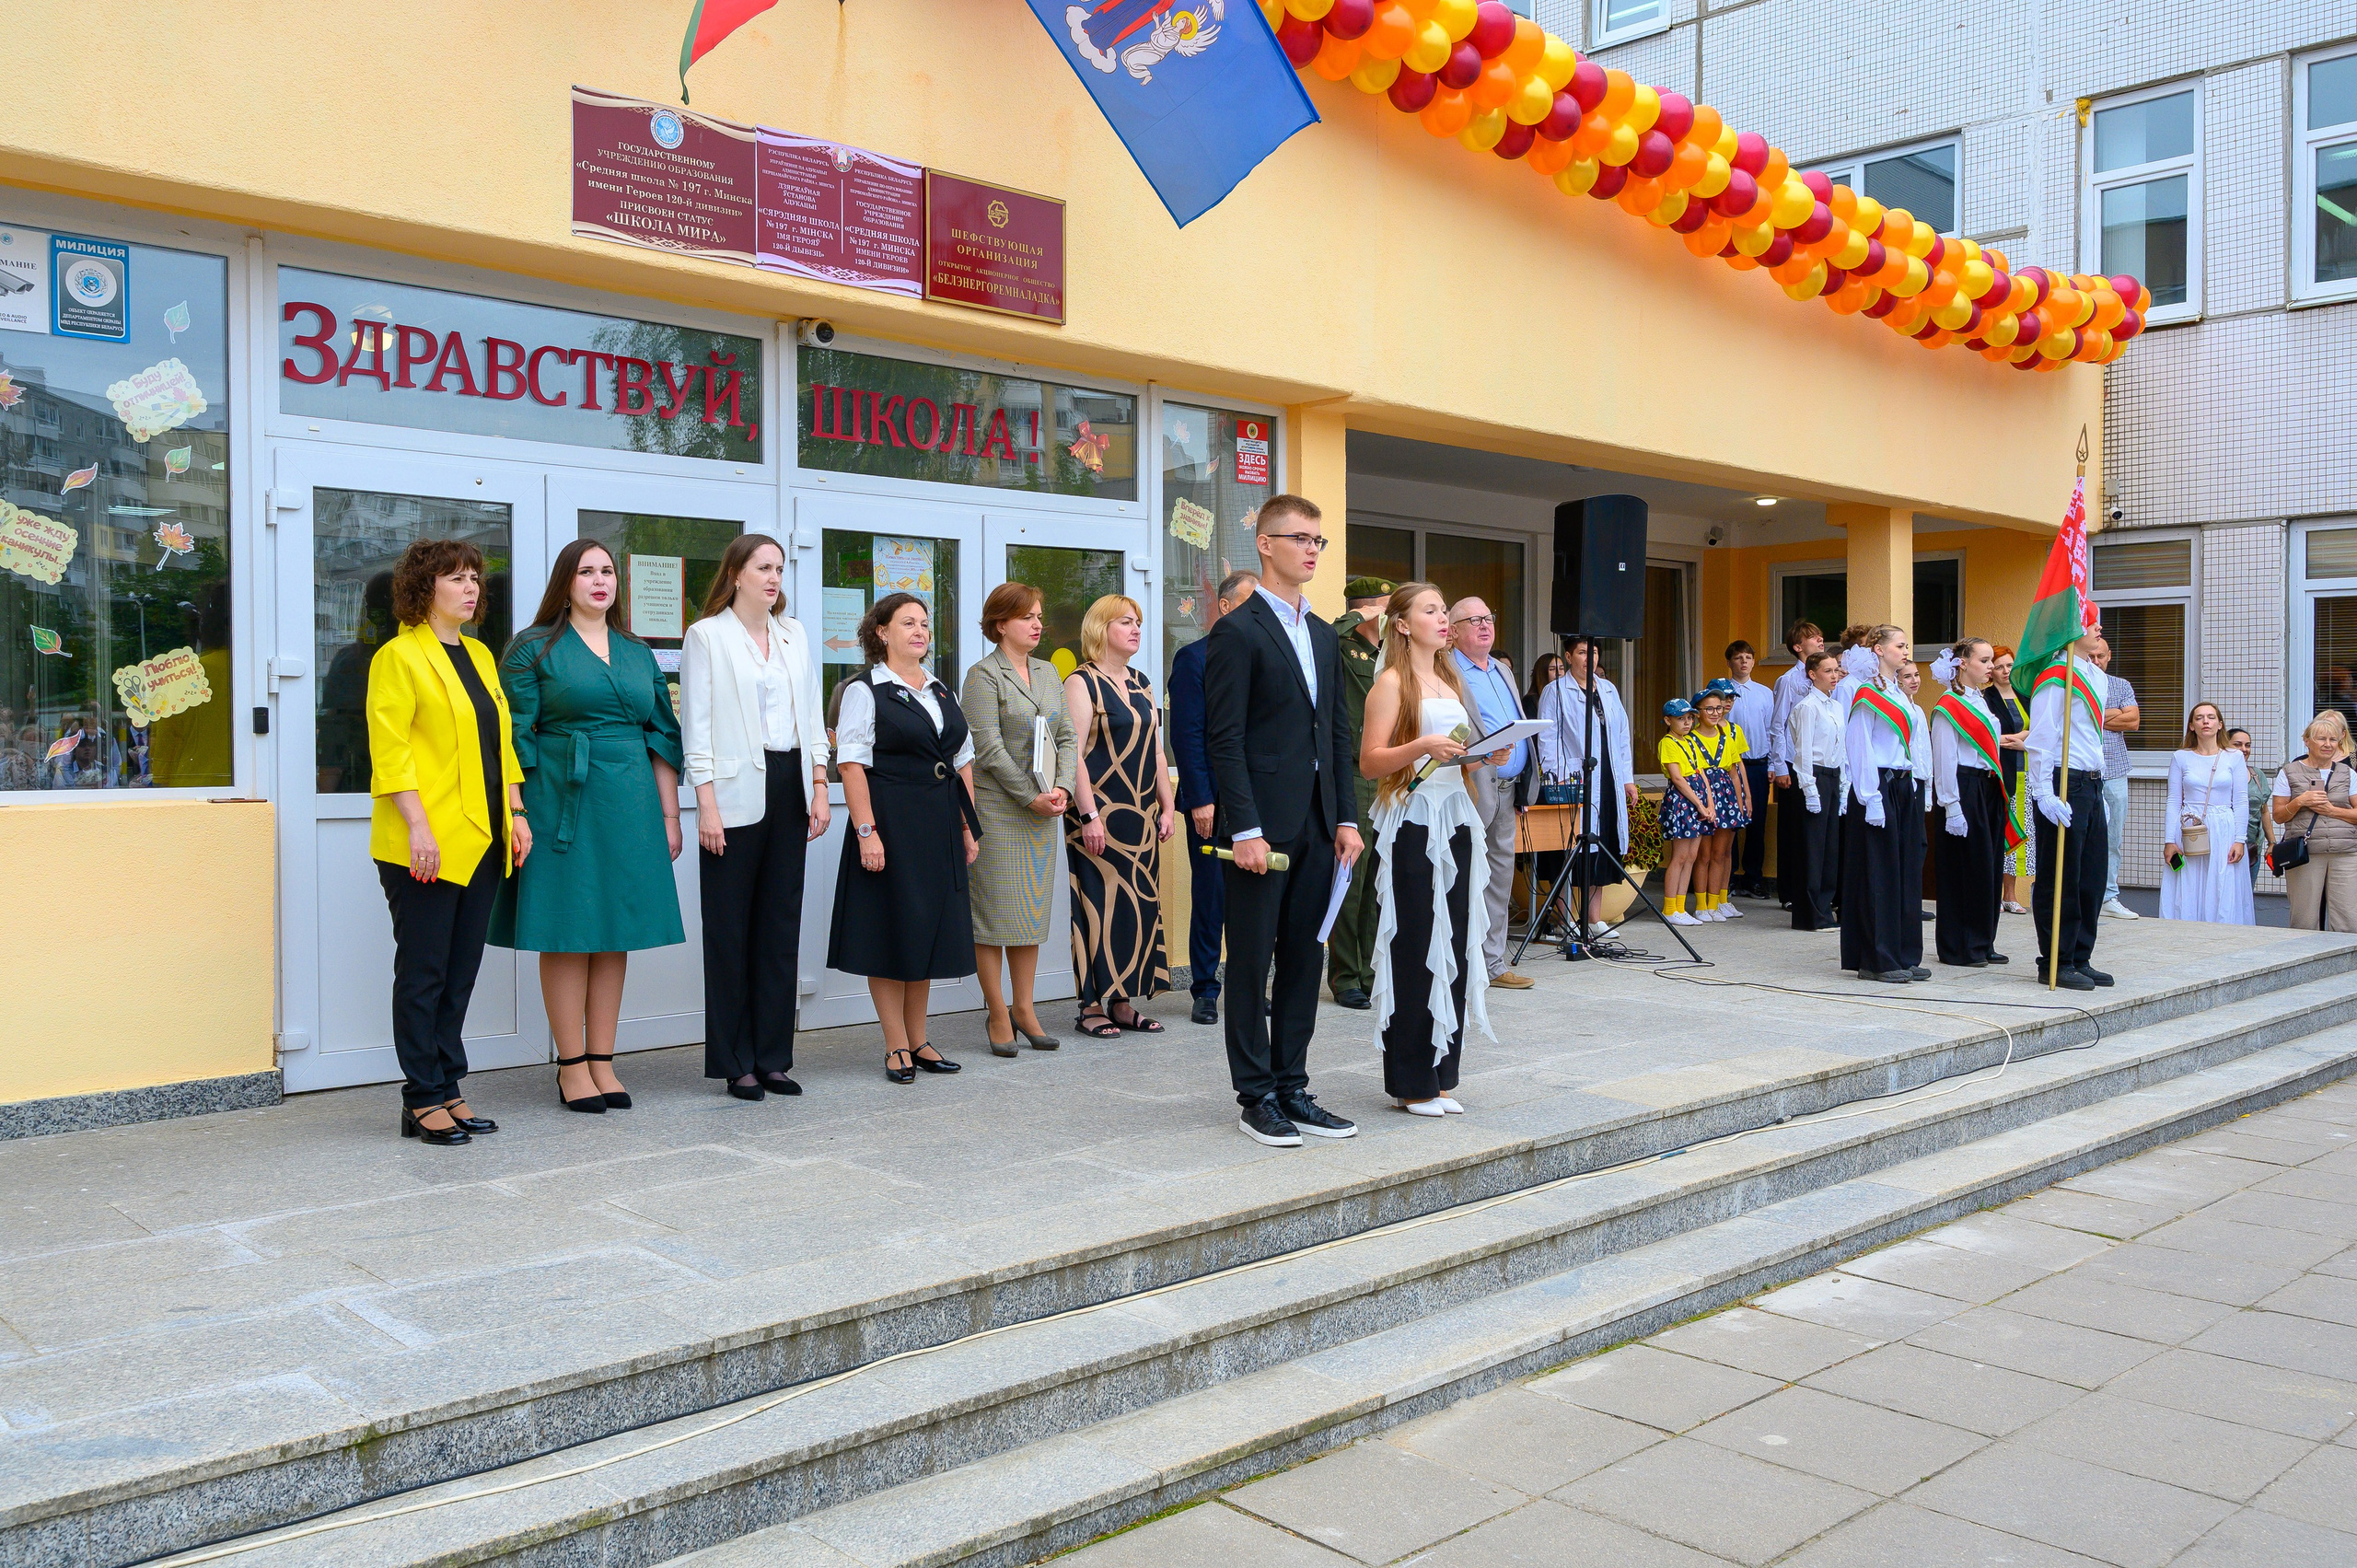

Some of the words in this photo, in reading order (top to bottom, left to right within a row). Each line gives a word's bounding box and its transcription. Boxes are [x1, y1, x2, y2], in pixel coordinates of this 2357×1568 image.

[618, 142, 715, 169] ГОСУДАРСТВЕННОМУ
[768, 148, 801, 160] РЭСПУБЛІКА
[803, 157, 829, 167] БЕЛАРУСЬ
[598, 149, 667, 170] УЧРЕЖДЕНИЮ
[668, 165, 734, 186] ОБРАЗОВАНИЯ
[576, 160, 628, 179] «Средняя
[631, 173, 665, 186] школа
[668, 179, 679, 190] №
[682, 180, 702, 194] 197
[703, 189, 712, 197] г.
[714, 188, 753, 205] Минска
[777, 182, 821, 197] ДЗЯРЖАЎНАЯ
[888, 176, 913, 186] БЕЛАРУСЬ
[587, 180, 622, 193] имени
[626, 185, 663, 201] Героев
[667, 193, 692, 207] 120-й
[695, 203, 743, 217] дивизии»
[783, 199, 818, 210] АДУКАЦЫІ
[621, 201, 675, 219] ПРИСВОЕН
[678, 212, 714, 226] СТАТУС
[759, 207, 807, 223] «СЯРЭДНЯЯ
[808, 217, 840, 230] ШКОЛА
[856, 201, 911, 217] ГОСУДАРСТВЕННОЕ
[864, 210, 904, 223] УЧРЕЖДЕНИЕ
[606, 211, 674, 234] «ШКОЛА
[678, 223, 726, 243] МИРА»
[863, 215, 904, 230] ОБРАЗОВАНИЯ
[777, 232, 791, 241] ІМЯ
[792, 234, 821, 247] ГЕРОЯЎ
[799, 226, 834, 240] МІНСКА
[844, 226, 888, 239] «СРЕДНЯЯ
[889, 233, 921, 247] ШКОЛА
[951, 228, 1043, 256] ШЕФСТВУЮЩАЯ
[55, 239, 125, 258] МИЛИЦИЯ
[772, 242, 791, 252] 120-Й
[856, 248, 881, 260] ИМЕНИ
[882, 252, 908, 263] ГЕРОЕВ
[881, 243, 915, 257] МИНСКА
[854, 258, 871, 269] 120-Й
[873, 261, 910, 274] ДИВИЗИИ»
[958, 245, 1039, 270] ОРГАНИЗАЦИЯ
[938, 260, 972, 273] ОТКРЫТОЕ
[976, 267, 1020, 282] АКЦИОНЕРНОЕ
[1022, 277, 1055, 289] ОБЩЕСТВО
[933, 272, 1061, 306] «БЕЛЭНЕРГОРЕМНАЛАДКА»
[132, 370, 162, 389] Буду
[283, 302, 759, 442] ЗДРАВСТВУЙ,
[123, 372, 186, 408] отличницей!
[1239, 453, 1266, 466] ЗДЕСЬ
[1238, 473, 1267, 482] МИЛИЦИЮ
[17, 516, 41, 529] уже
[43, 526, 70, 542] жду
[1180, 513, 1208, 530] знаниям!
[14, 528, 63, 552] осенние
[637, 561, 678, 569] ВНИМАНИЕ!
[144, 654, 190, 677] Люблю
[147, 663, 197, 692] учиться!
